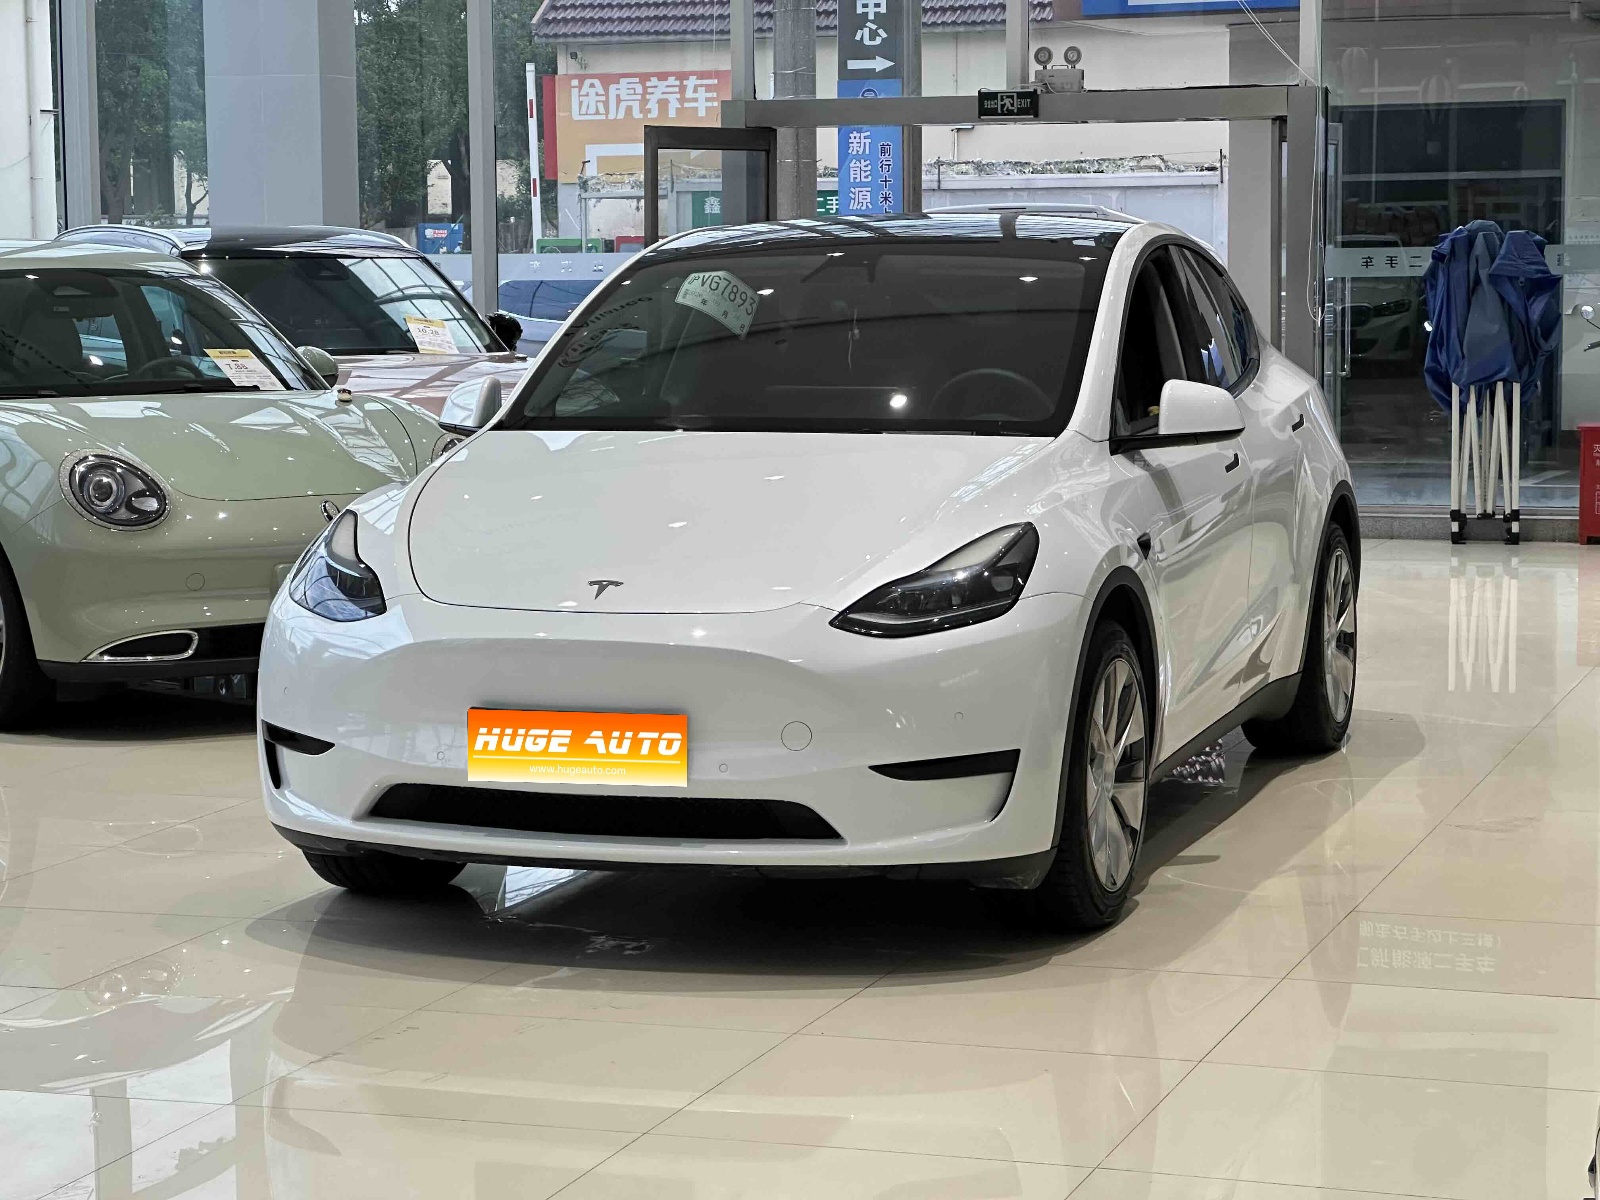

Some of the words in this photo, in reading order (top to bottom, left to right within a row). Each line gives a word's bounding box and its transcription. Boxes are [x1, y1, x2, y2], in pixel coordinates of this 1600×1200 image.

[854, 0, 888, 46] 中心
[571, 75, 718, 121] 途虎养车
[1017, 98, 1031, 108] EXIT
[848, 131, 872, 210] 新能源
[704, 196, 721, 213] 鑫
